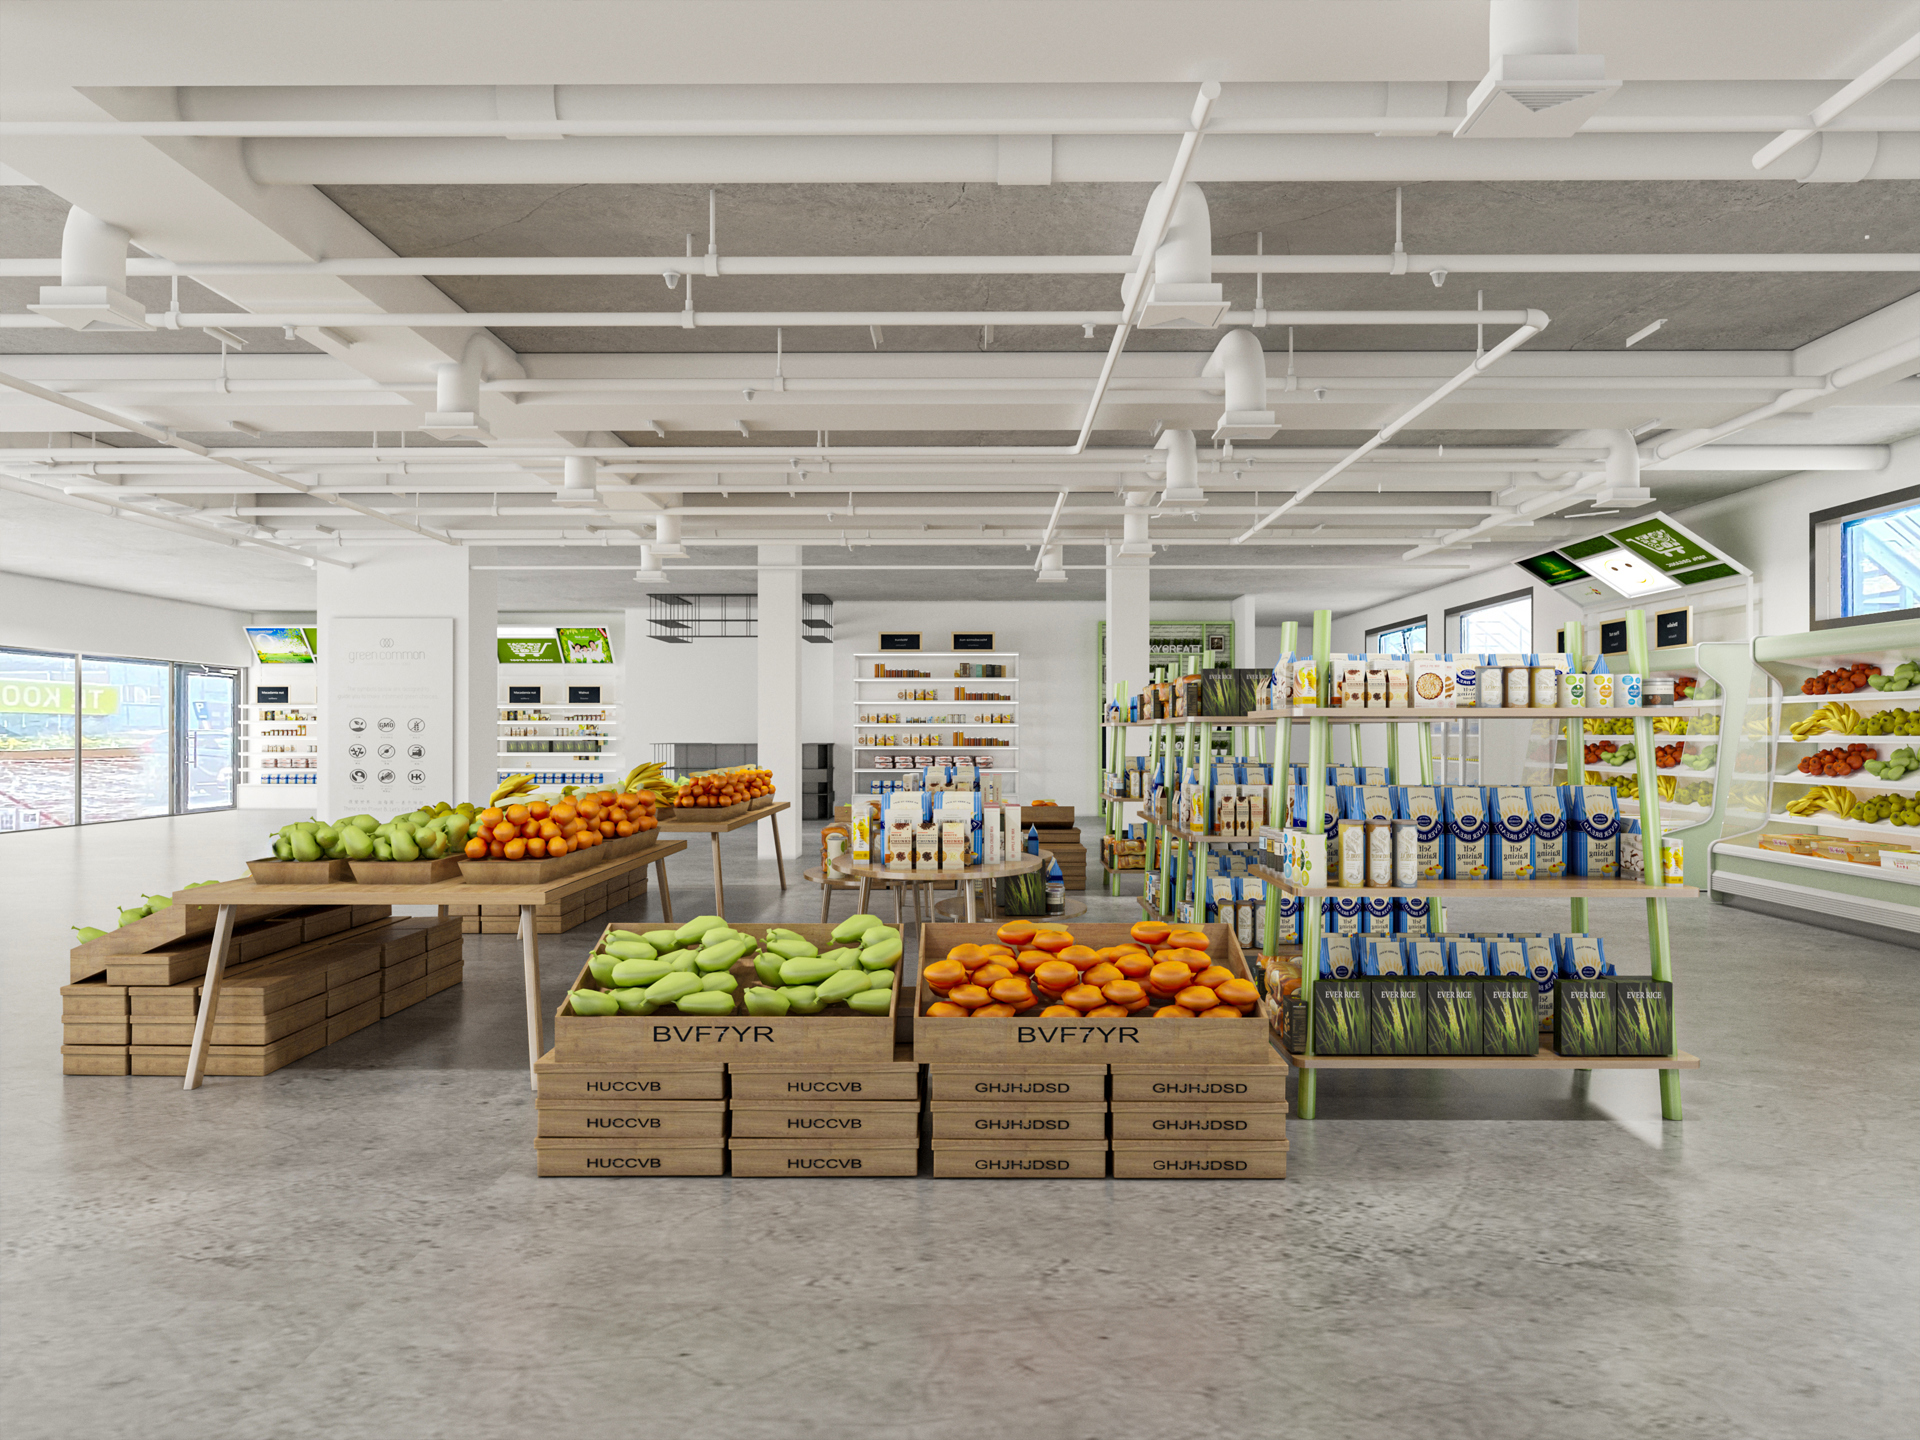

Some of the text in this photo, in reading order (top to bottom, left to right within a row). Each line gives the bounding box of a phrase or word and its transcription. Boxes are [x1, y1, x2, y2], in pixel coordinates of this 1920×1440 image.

[348, 651, 426, 664] green common
[195, 703, 205, 713] P
[1325, 991, 1360, 999] EVER RICE
[1381, 991, 1416, 999] EVER RICE
[1437, 991, 1472, 999] EVER RICE
[1493, 991, 1528, 999] EVER RICE
[1570, 991, 1606, 999] EVER RICE
[1626, 991, 1662, 999] EVER RICE
[654, 1026, 774, 1042] BVF7YR
[1018, 1027, 1139, 1043] BVF7YR
[587, 1082, 661, 1091] HUCCVB
[788, 1082, 861, 1092] HUCCVB
[975, 1083, 1069, 1093] GHJHJDSD
[1153, 1083, 1247, 1093] GHJHJDSD
[587, 1118, 660, 1128] HUCCVB
[788, 1119, 861, 1128] HUCCVB
[975, 1120, 1069, 1129] GHJHJDSD
[1153, 1120, 1247, 1130] GHJHJDSD
[587, 1158, 661, 1168] HUCCVB
[788, 1159, 862, 1168] HUCCVB
[975, 1160, 1069, 1170] GHJHJDSD
[1154, 1161, 1247, 1170] GHJHJDSD
